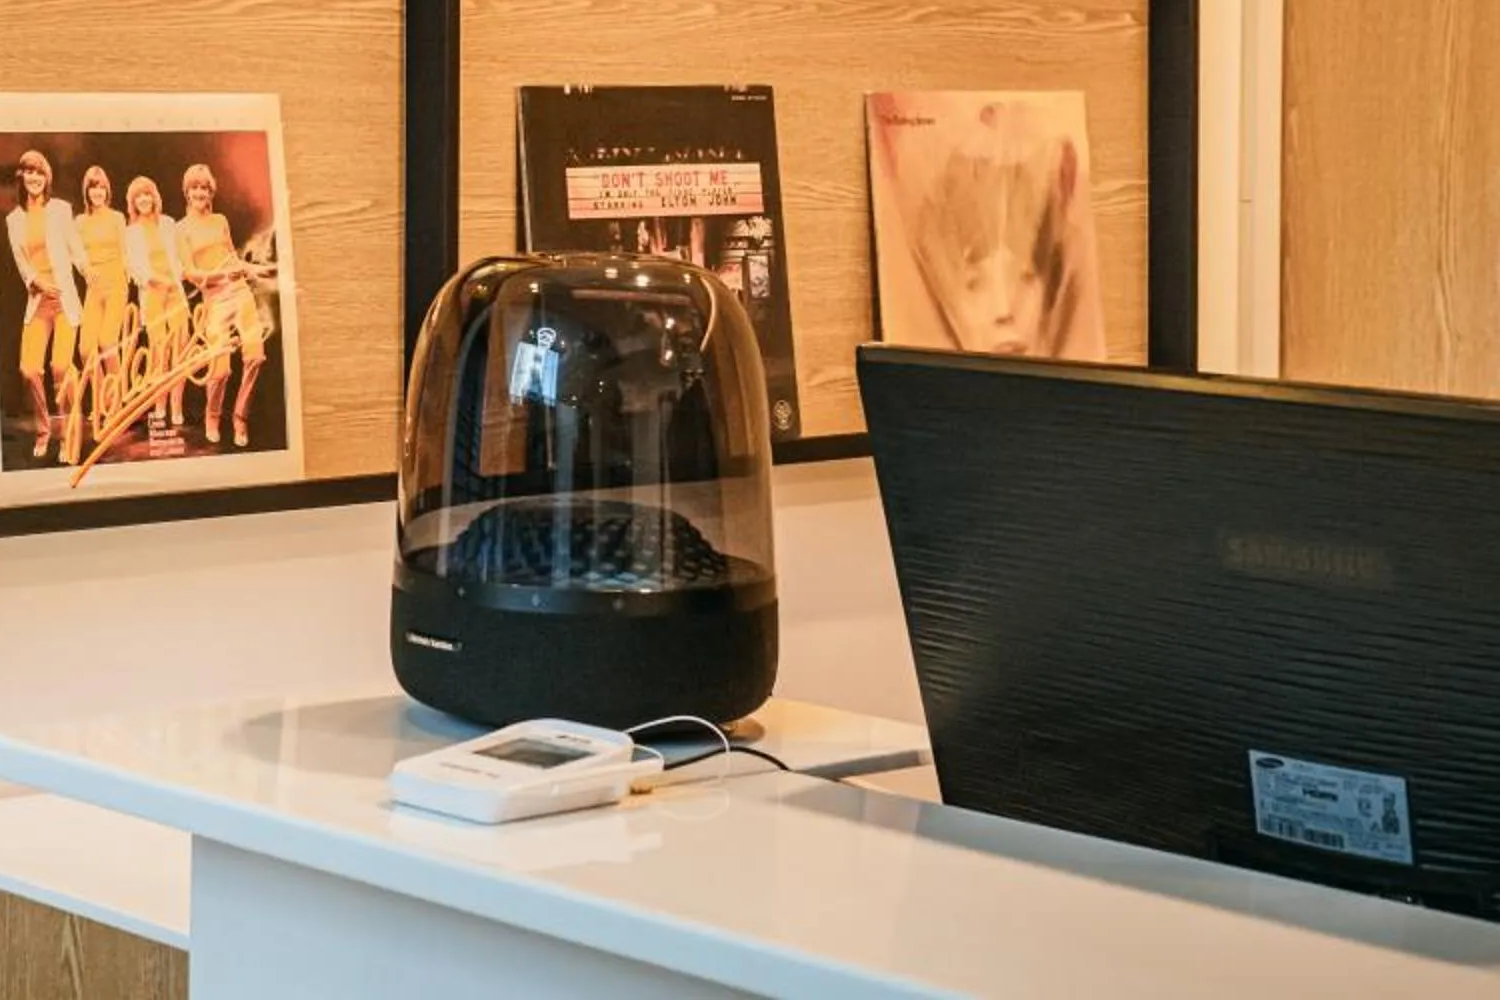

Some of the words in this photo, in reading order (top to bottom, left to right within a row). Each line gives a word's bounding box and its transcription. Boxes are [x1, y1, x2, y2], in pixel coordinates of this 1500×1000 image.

[601, 172, 645, 189] DON'T
[654, 170, 700, 187] SHOOT
[660, 196, 697, 208] ELTON
